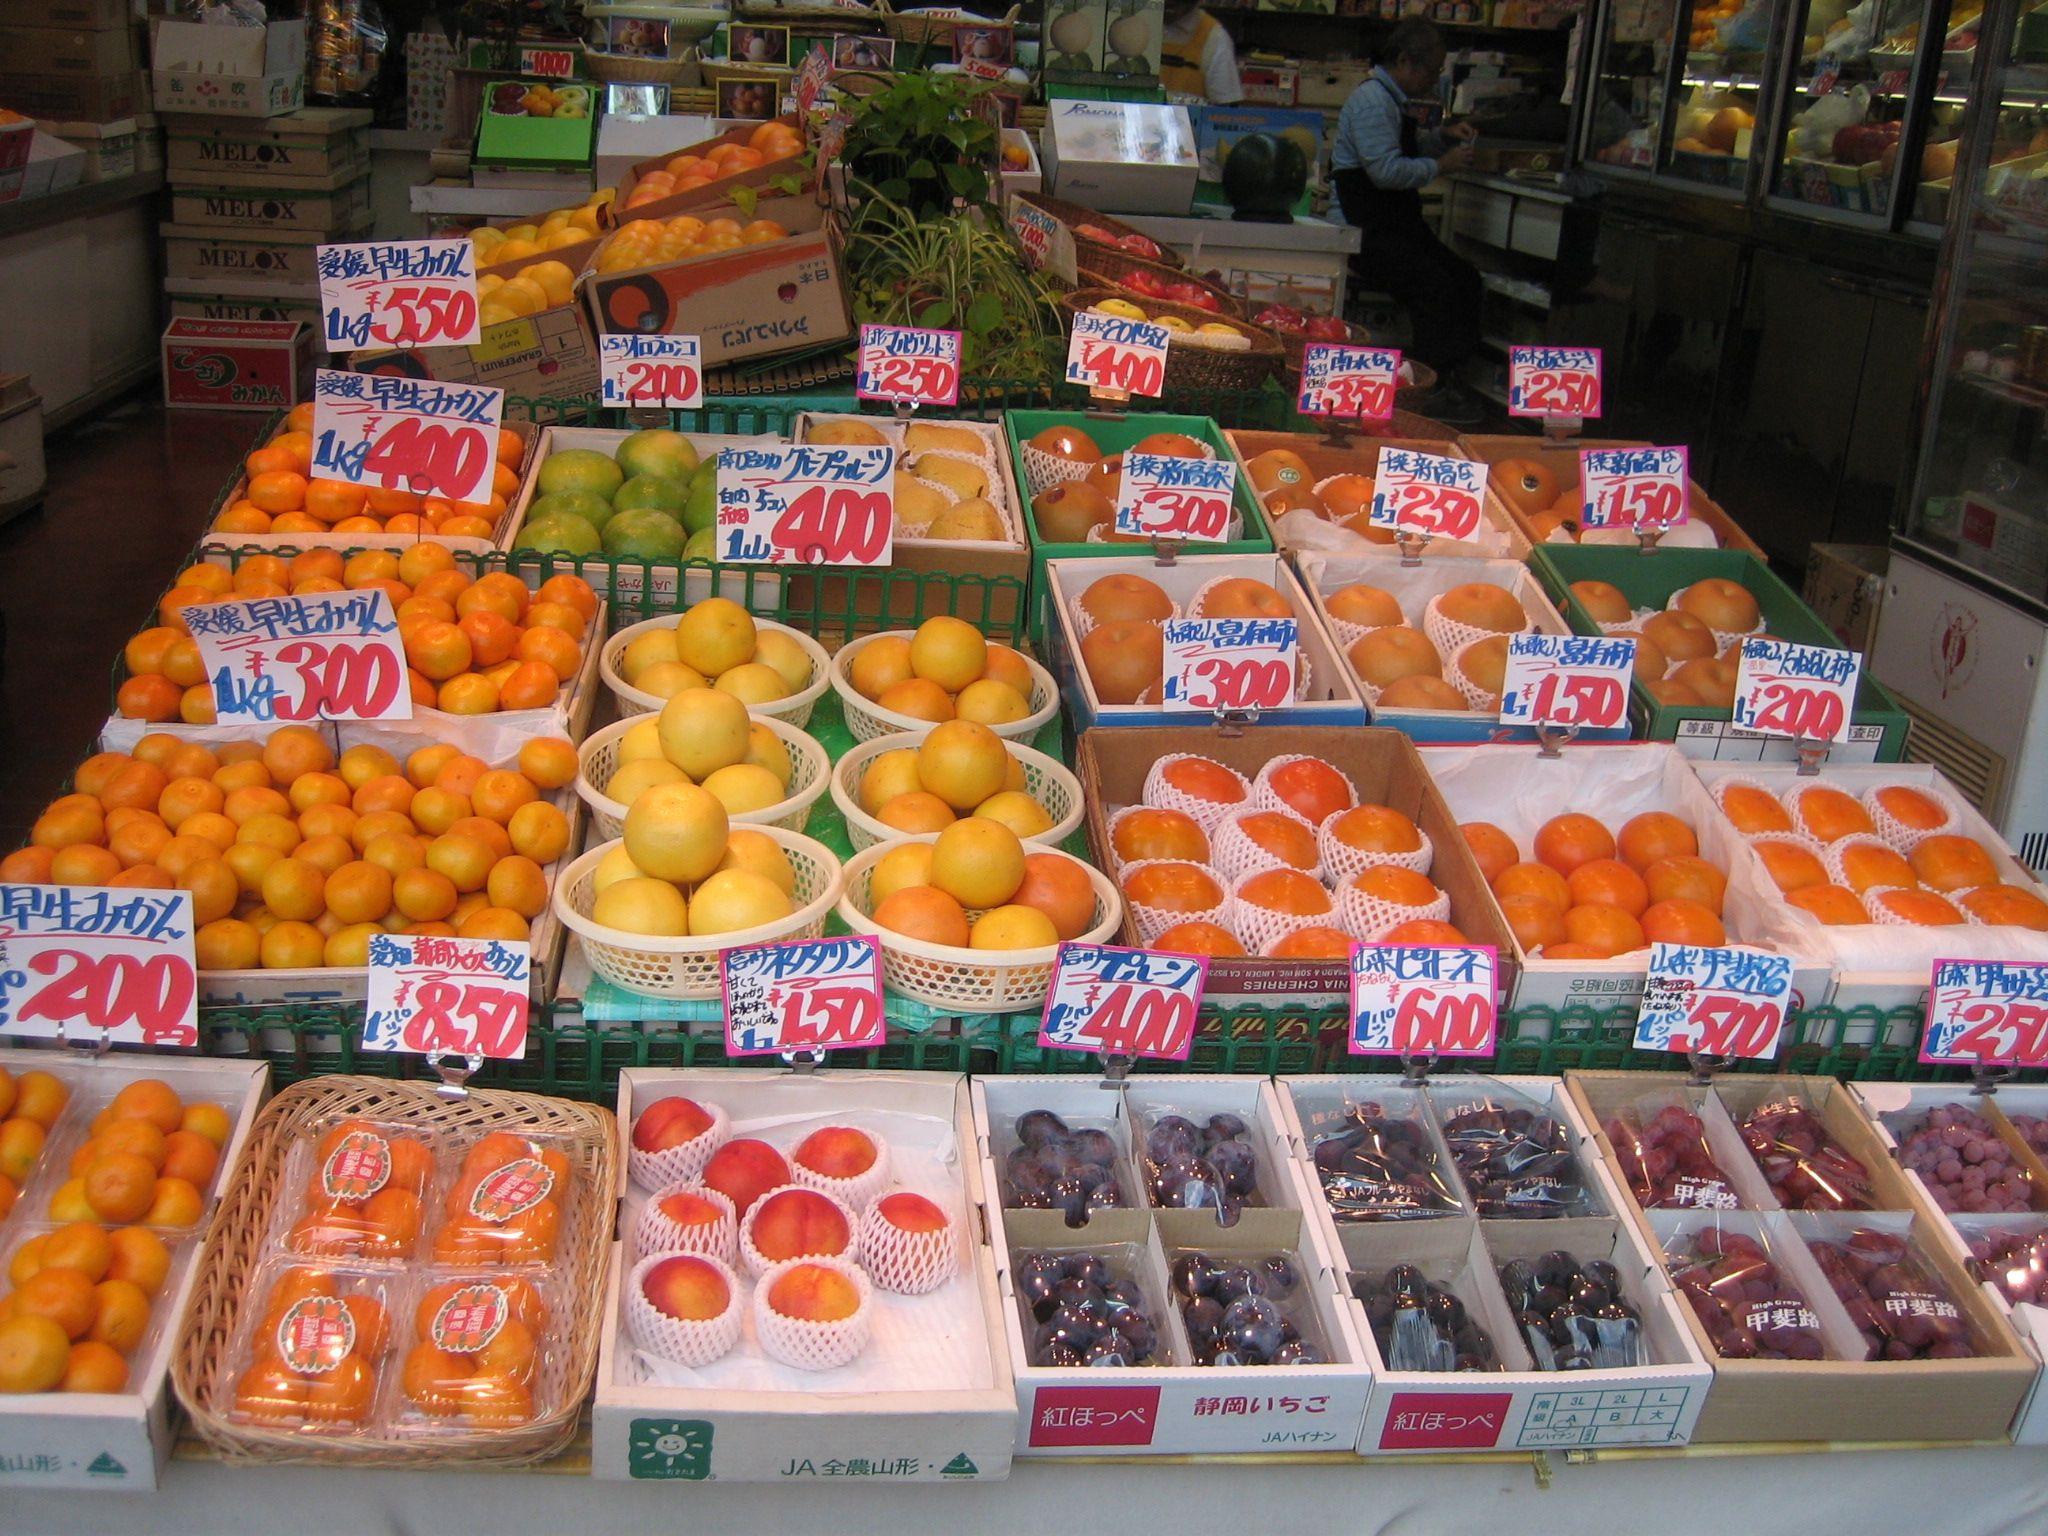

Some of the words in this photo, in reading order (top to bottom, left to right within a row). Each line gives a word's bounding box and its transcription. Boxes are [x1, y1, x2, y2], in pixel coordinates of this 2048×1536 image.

[327, 307, 376, 347] 1kg
[313, 429, 373, 482] 1kg
[212, 666, 284, 721] 1kg
[1685, 722, 1715, 736] 等級
[1242, 979, 1318, 993] CHERRIES
[1673, 1184, 1738, 1210] 甲斐路
[1885, 1298, 1959, 1319] 甲斐路
[1746, 1308, 1820, 1333] 甲斐路
[1041, 1405, 1146, 1428] 紅ほっぺ
[1193, 1395, 1332, 1417] 静岡いちご
[1609, 1411, 1621, 1422] B
[1392, 1410, 1495, 1432] 紅ほっぺ
[1261, 1431, 1337, 1443] JAハイナン
[781, 1458, 816, 1477] JA
[821, 1457, 920, 1477] 全農山形
